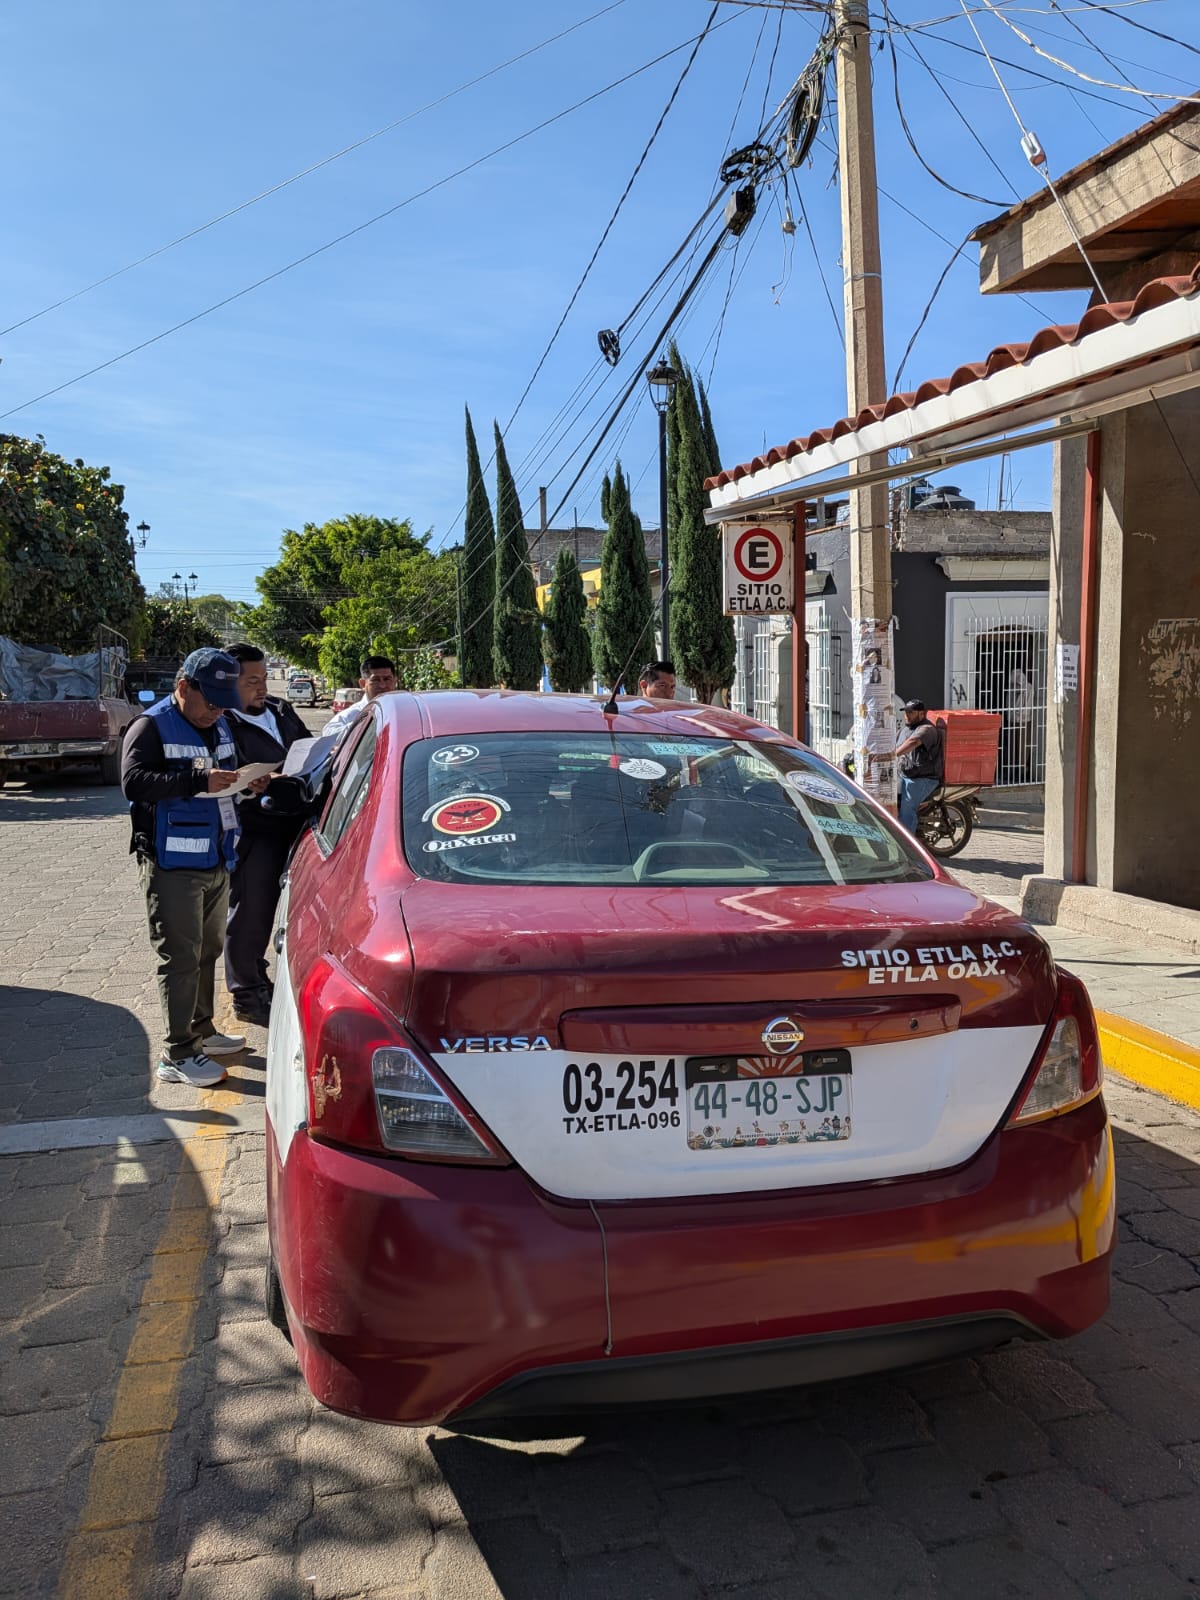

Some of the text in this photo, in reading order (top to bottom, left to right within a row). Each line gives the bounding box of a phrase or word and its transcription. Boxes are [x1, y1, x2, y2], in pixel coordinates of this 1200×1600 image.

[748, 541, 770, 569] E
[737, 583, 782, 596] SITIO
[729, 596, 790, 611] ETLA A.C.
[437, 746, 474, 762] 23
[422, 833, 517, 853] Oaxaca
[841, 941, 1022, 968] SITIO ETLA A.C.
[868, 959, 1006, 985] ETLA OAX.
[439, 1035, 552, 1054] VERSA
[766, 1033, 800, 1041] NISSAN
[562, 1058, 680, 1114] 03-254
[694, 1075, 843, 1120] 44-48-SJP
[562, 1110, 681, 1135] TX-ETLA-096
